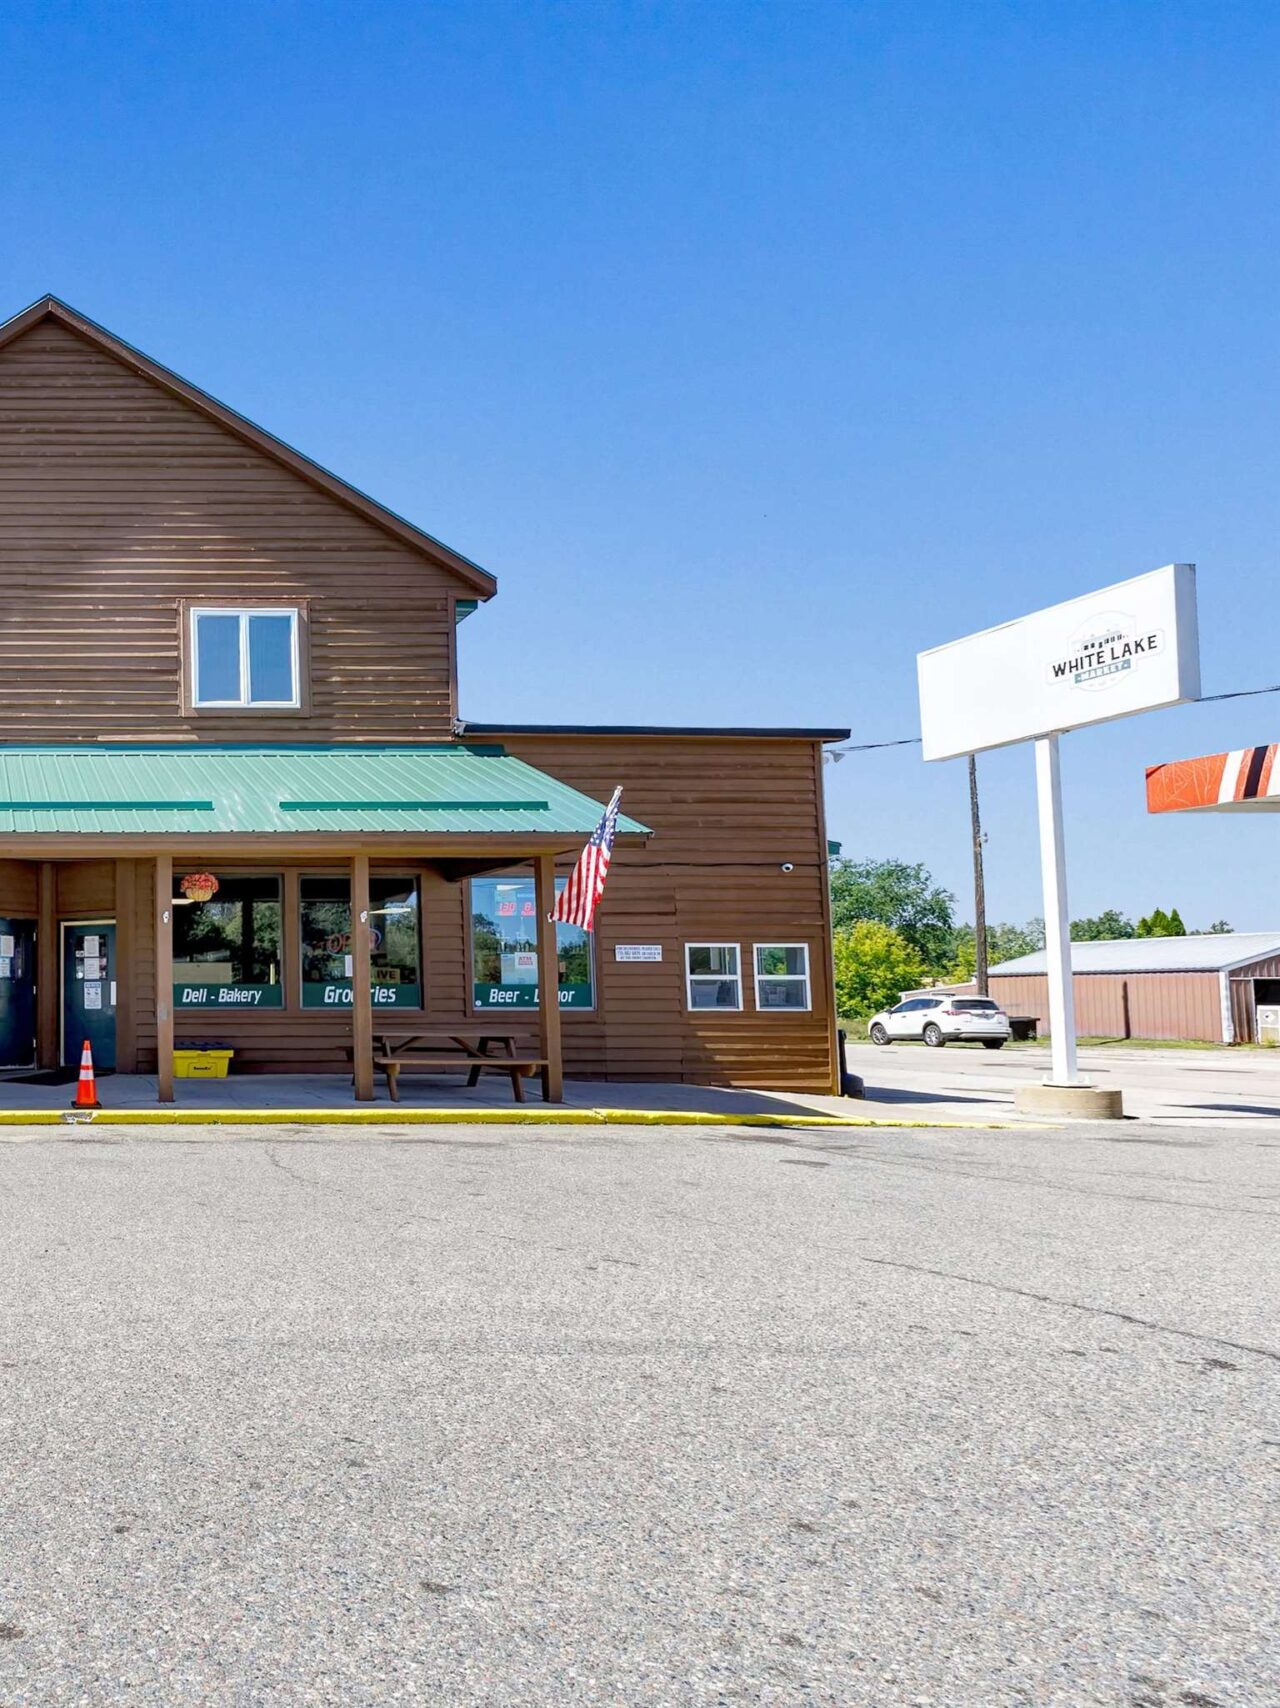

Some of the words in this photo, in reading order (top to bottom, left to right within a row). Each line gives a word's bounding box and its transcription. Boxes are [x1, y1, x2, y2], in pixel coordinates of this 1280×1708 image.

[1053, 650, 1106, 677] WHITE
[1111, 635, 1158, 660] LAKE
[376, 970, 396, 980] IVE
[182, 988, 207, 1003] Deli
[218, 988, 262, 1004] Bakery
[489, 988, 520, 1003] Beer
